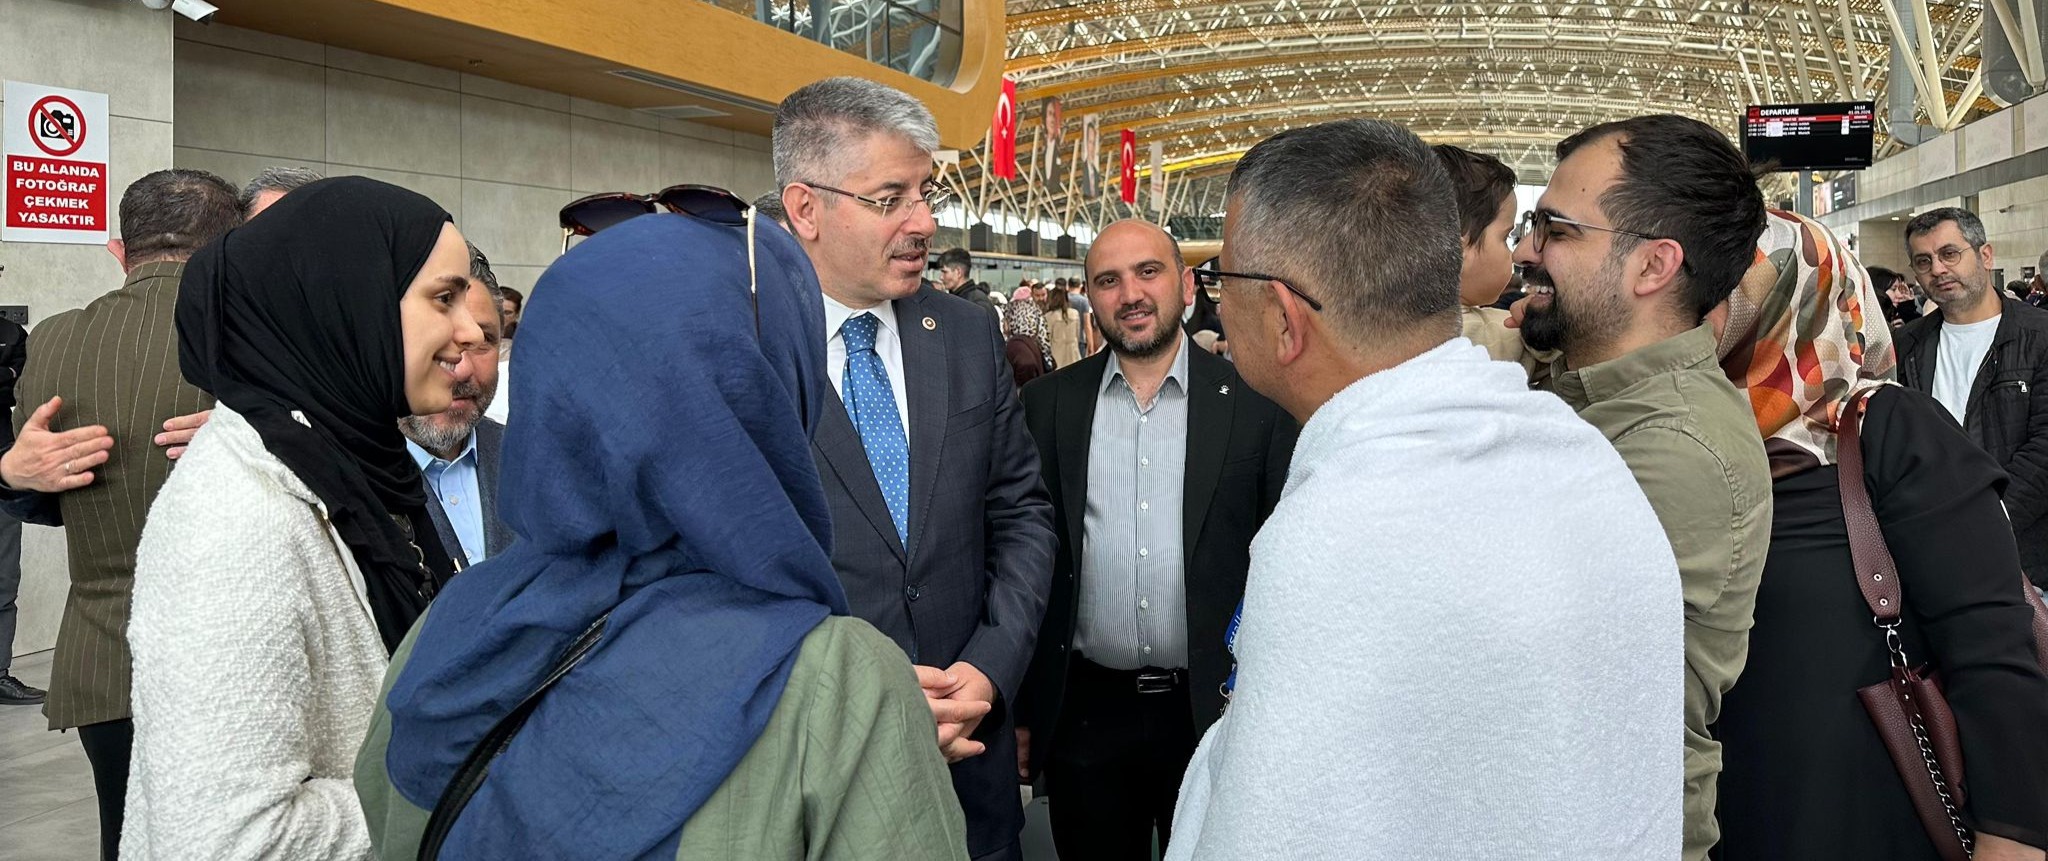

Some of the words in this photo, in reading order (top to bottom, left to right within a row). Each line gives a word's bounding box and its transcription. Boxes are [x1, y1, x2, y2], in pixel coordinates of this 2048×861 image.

[1760, 108, 1799, 116] DEPARTURE
[13, 160, 35, 172] BU
[39, 163, 100, 178] ALANDA
[16, 178, 97, 193] FOTOĞRAF
[24, 195, 89, 209] ÇEKMEK
[18, 212, 95, 226] YASAKTIR
